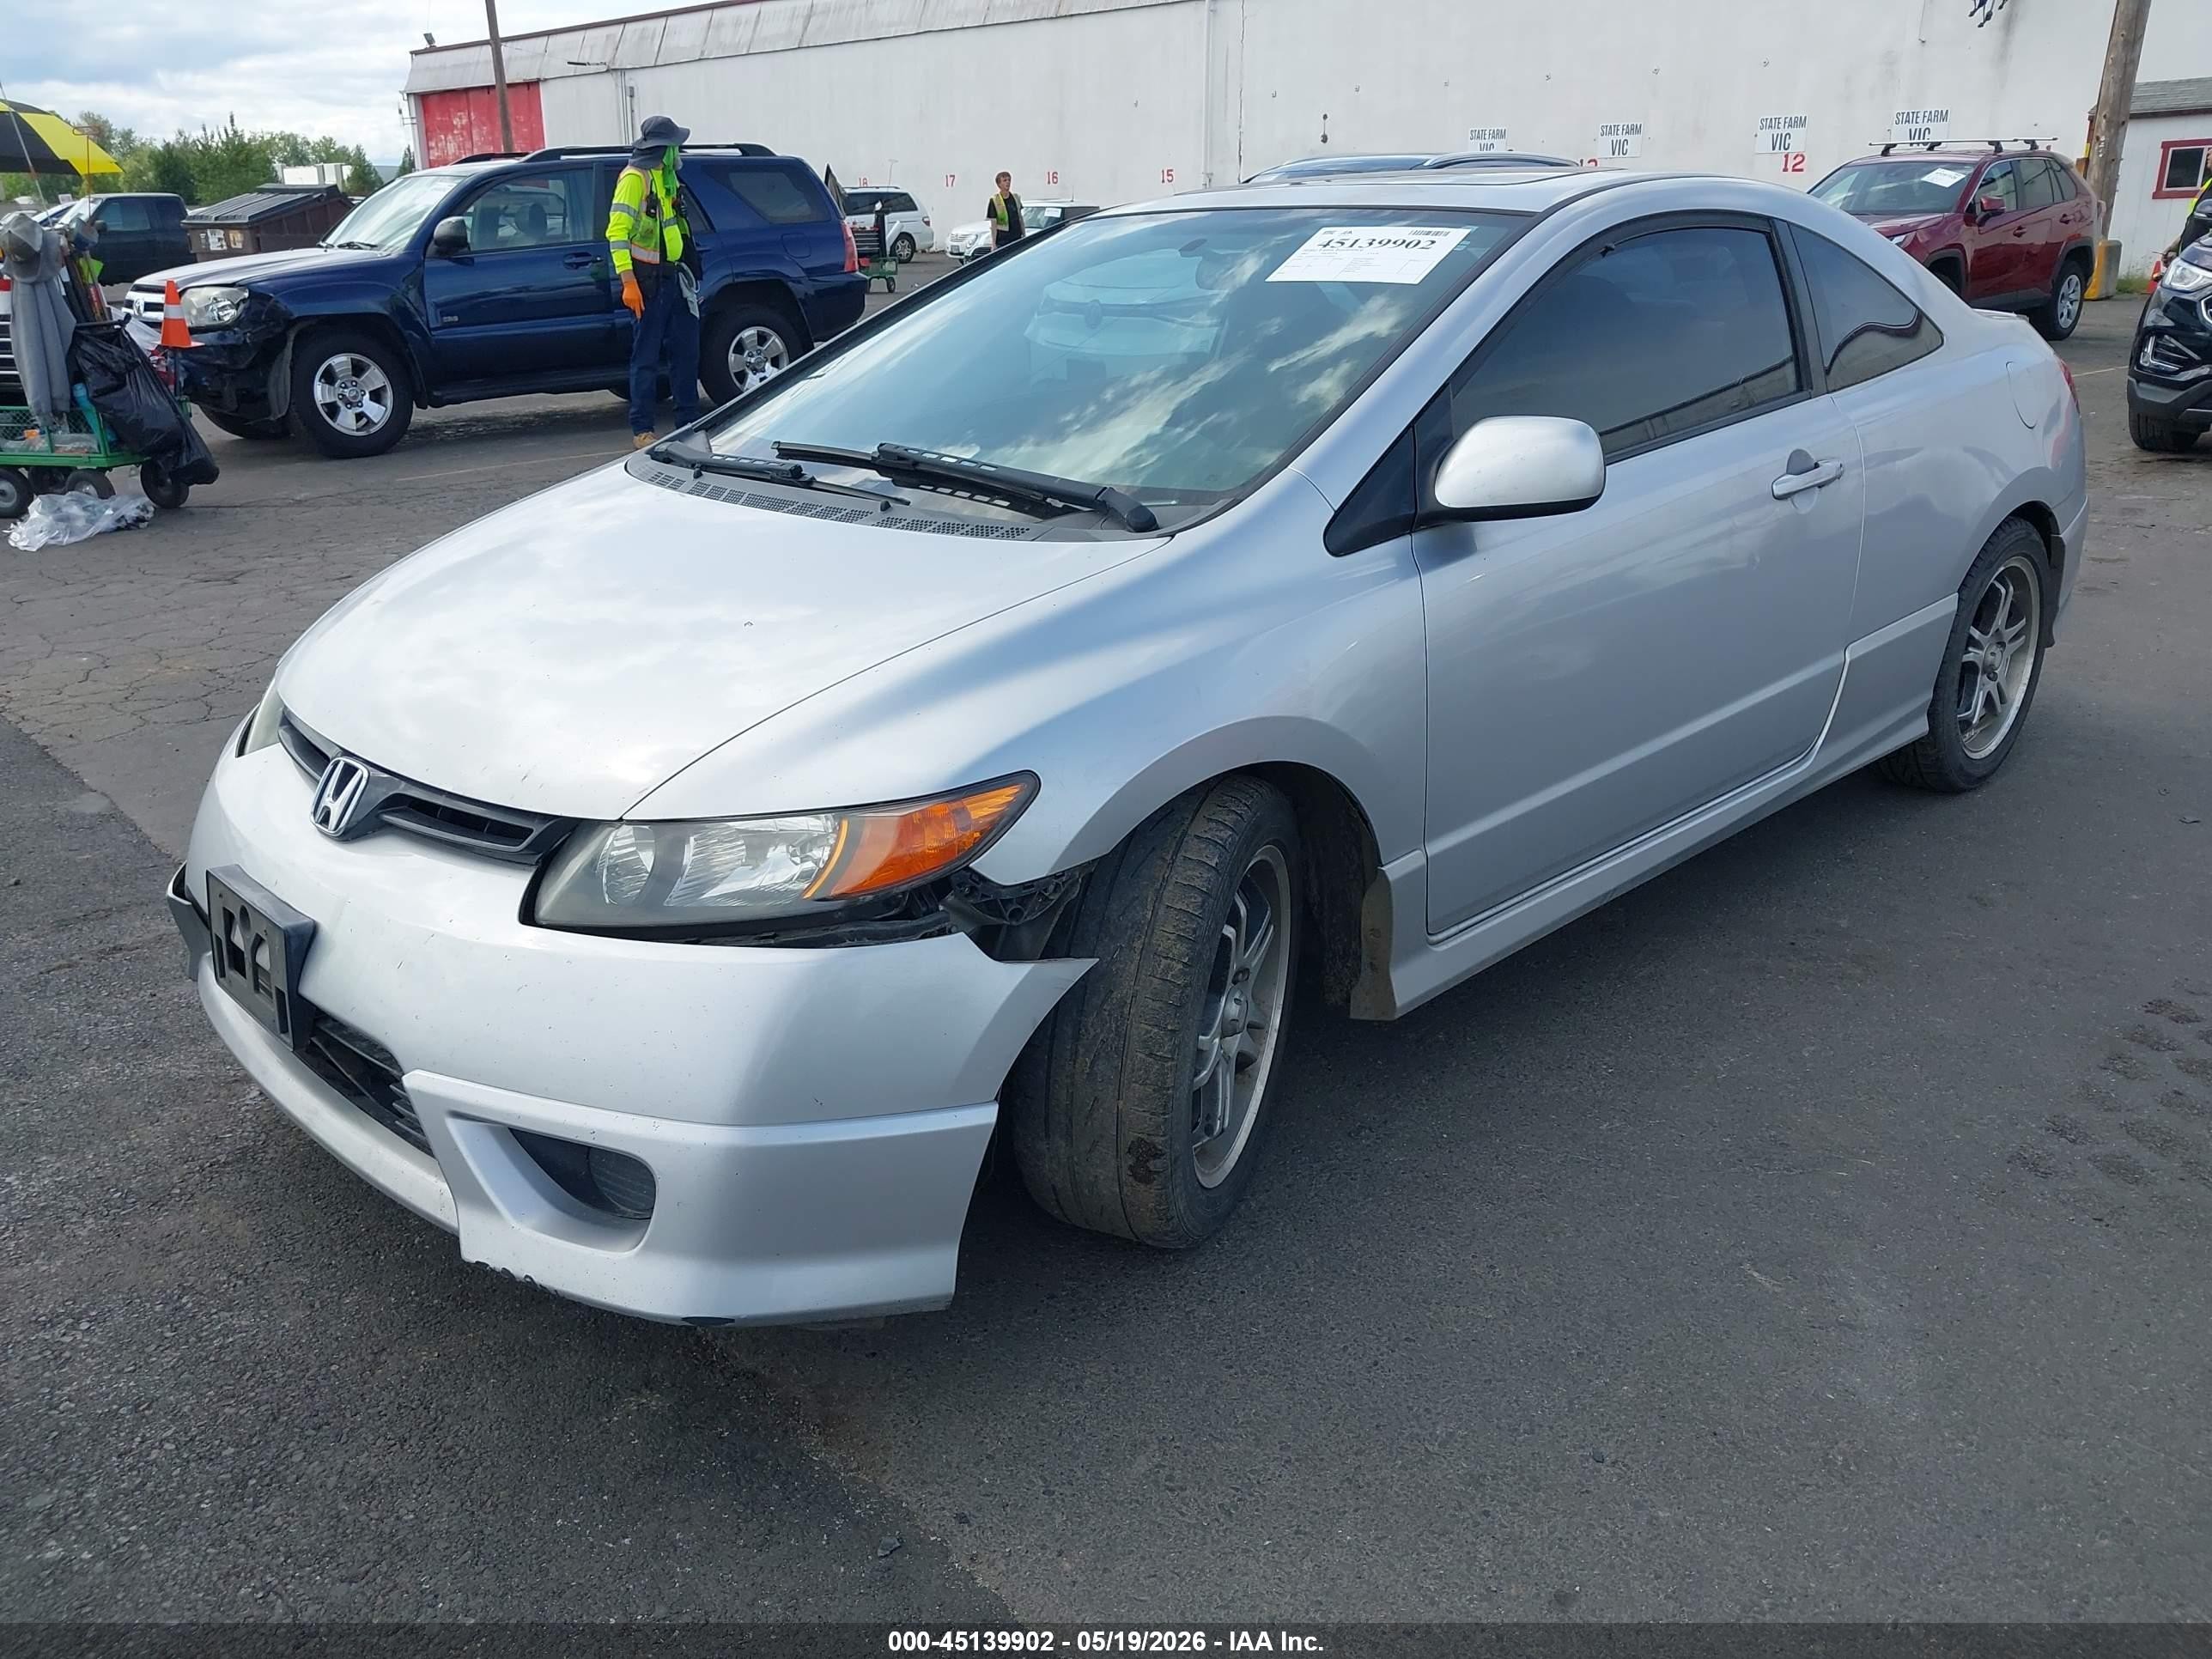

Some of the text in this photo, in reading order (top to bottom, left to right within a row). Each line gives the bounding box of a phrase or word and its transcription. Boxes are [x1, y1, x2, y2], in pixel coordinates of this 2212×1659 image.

[1759, 115, 1807, 131] STATE FARM
[1894, 110, 1949, 125] STATE FARM
[1469, 128, 1506, 141] STATE FARM
[1600, 123, 1642, 137] STATE FARM
[1909, 126, 1931, 147] VIC
[1611, 138, 1629, 156] VIC
[1771, 131, 1791, 151] VIC
[1782, 153, 1806, 173] 12
[945, 174, 956, 187] 17
[1047, 171, 1059, 185] 16
[1161, 168, 1174, 184] 15
[1317, 237, 1437, 251] 45139902
